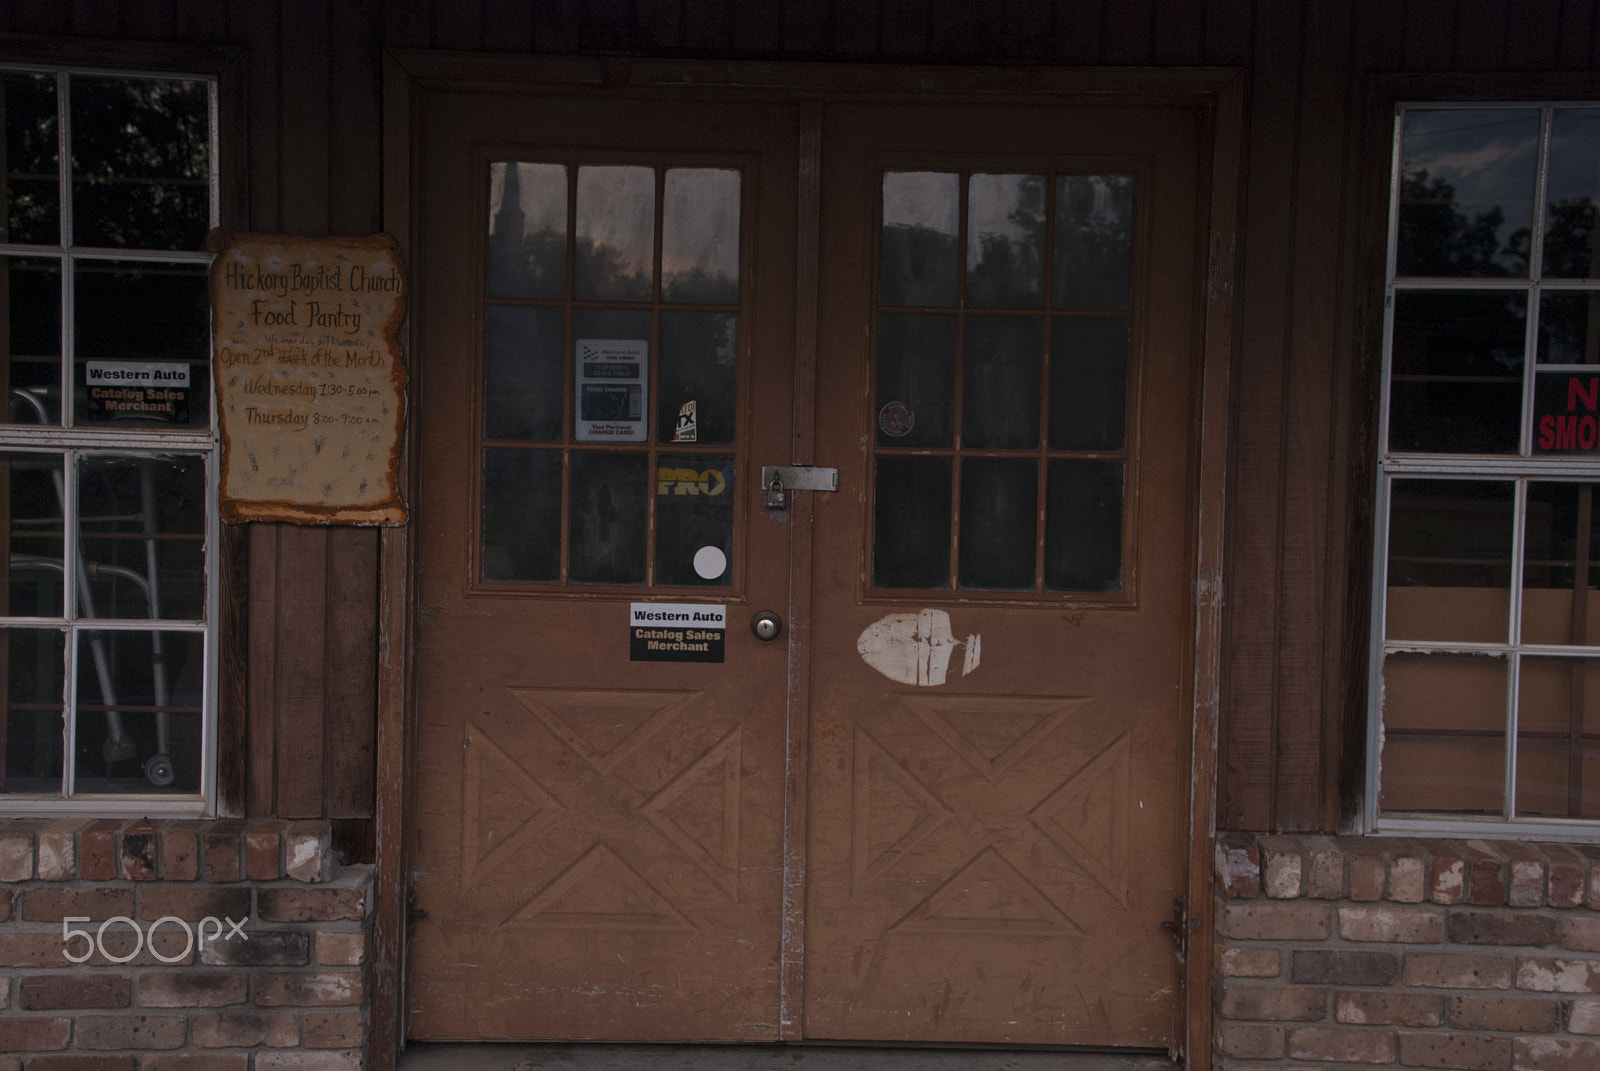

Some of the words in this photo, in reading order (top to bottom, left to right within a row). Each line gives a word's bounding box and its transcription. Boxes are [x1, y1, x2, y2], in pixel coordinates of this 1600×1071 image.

[224, 262, 288, 297] Hickory
[290, 263, 343, 296] Baptist
[350, 265, 401, 294] Church
[252, 300, 297, 326] Food
[306, 301, 361, 334] Pantry
[220, 347, 250, 369] Open
[252, 343, 274, 365] 2nd
[311, 349, 322, 365] of
[323, 348, 340, 366] the
[344, 350, 385, 368] Month
[90, 369, 150, 380] Western
[154, 370, 186, 380] Auto
[91, 387, 144, 402] Catalog
[146, 389, 185, 400] Sales
[243, 375, 316, 402] Wednesday
[104, 400, 172, 412] Merchant
[245, 407, 309, 432] Thursday
[1538, 414, 1600, 450] SMO
[657, 467, 726, 496] PRO
[634, 611, 690, 621] Western
[692, 612, 723, 622] Auto
[635, 628, 684, 641] Catalog
[686, 630, 721, 641] Sales
[647, 640, 709, 652] Merchant
